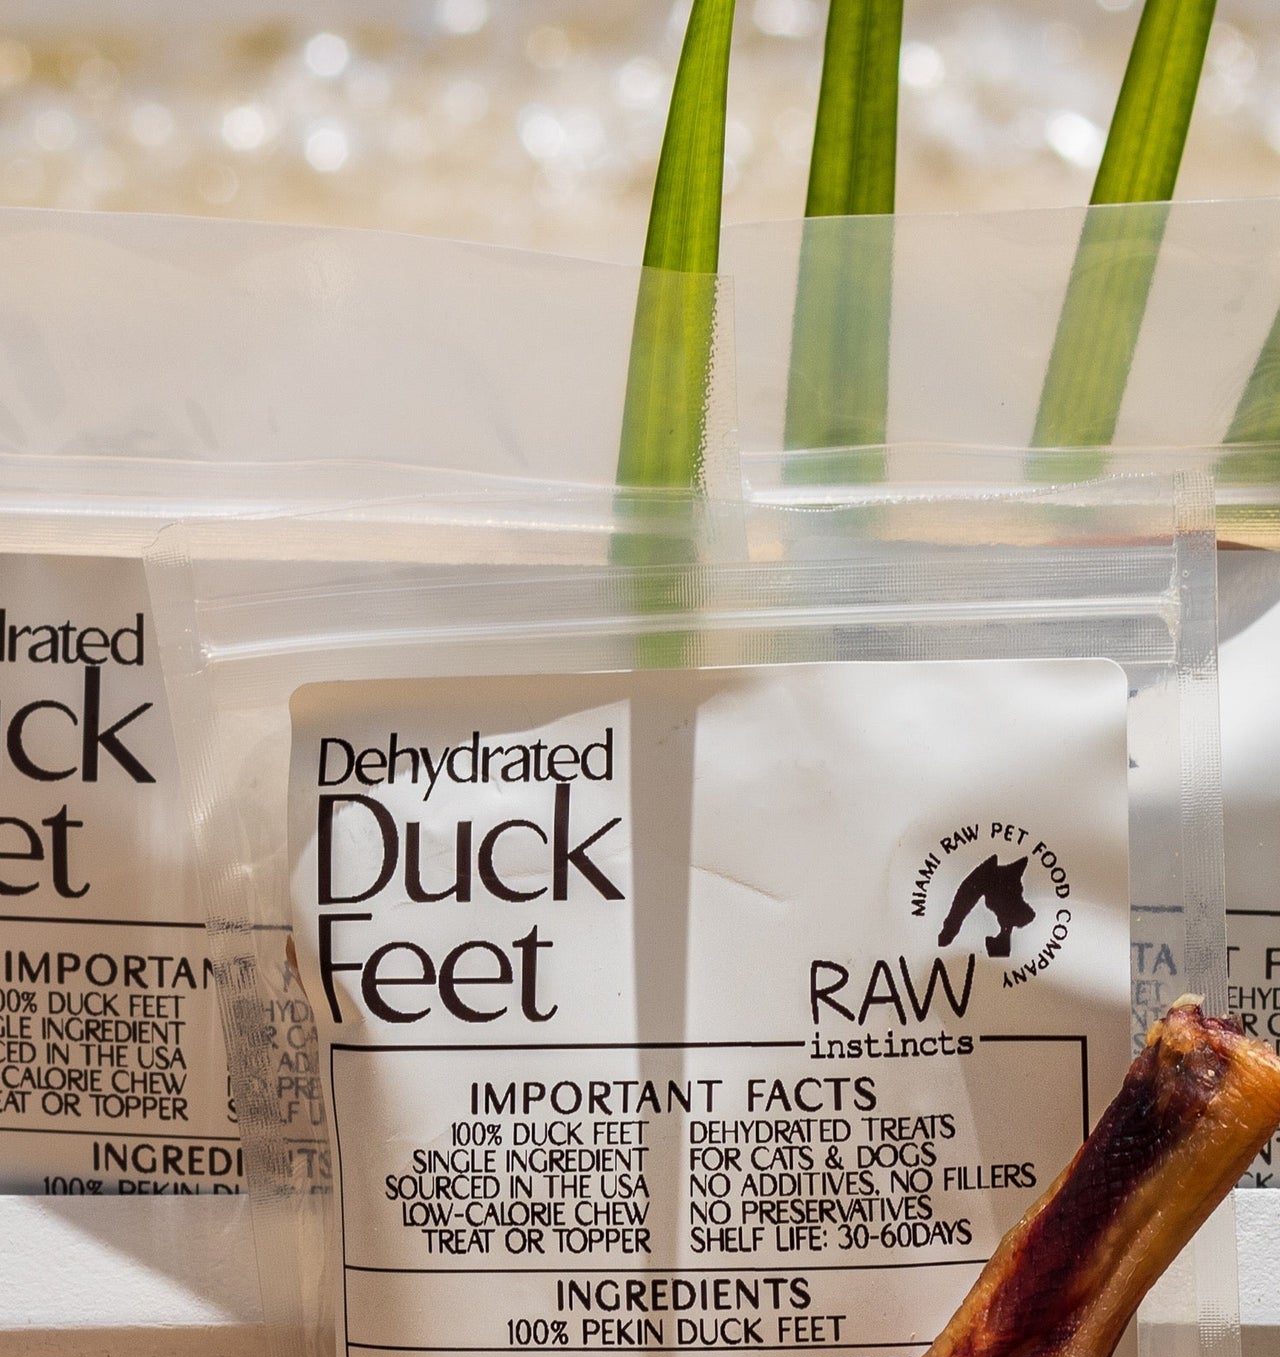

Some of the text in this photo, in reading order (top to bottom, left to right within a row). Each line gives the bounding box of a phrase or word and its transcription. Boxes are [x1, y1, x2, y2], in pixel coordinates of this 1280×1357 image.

[318, 727, 613, 801] Dehydrated
[318, 783, 625, 905] Duck
[940, 824, 979, 854] RAW
[991, 822, 1029, 845] PET
[911, 853, 941, 916] MIAMI
[1032, 841, 1070, 899] FOOD
[1003, 909, 1071, 988] COMPANY
[318, 913, 558, 1024] Feet
[810, 953, 975, 1025] RAW
[48, 991, 120, 1017] DUCK
[129, 994, 185, 1019] FEET
[42, 1017, 186, 1045] INGREDIENT
[810, 1029, 975, 1059] instincts
[47, 1043, 69, 1065] IN
[80, 1044, 128, 1068] THE
[137, 1046, 187, 1070] USA
[111, 1070, 188, 1096] CHEW
[470, 1076, 878, 1115] IMPORTANT FACTS
[41, 1091, 81, 1117] OR
[89, 1094, 188, 1121] TOPPER
[451, 1120, 649, 1147] 100% DUCK FEET
[690, 1114, 956, 1145] DEHYDRATED TREATS
[412, 1147, 649, 1174] SINGLE INGREDIENT
[690, 1142, 937, 1172] FOR CATS & DOGS
[385, 1173, 649, 1200] SOURCED IN THE USA
[690, 1162, 1037, 1198] NO ADDITIVES, NO FILLERS
[402, 1200, 650, 1227] LOW-CALORIE CHEW
[690, 1195, 933, 1225] NO PRESERVATIVES
[422, 1227, 652, 1254] TREAT OR TOPPER
[690, 1218, 972, 1253] SHELF LIFE: 30-60DAYS
[557, 1278, 812, 1311] INGREDIENTS
[508, 1315, 847, 1346] 100% PEKIN DUCK FEET
